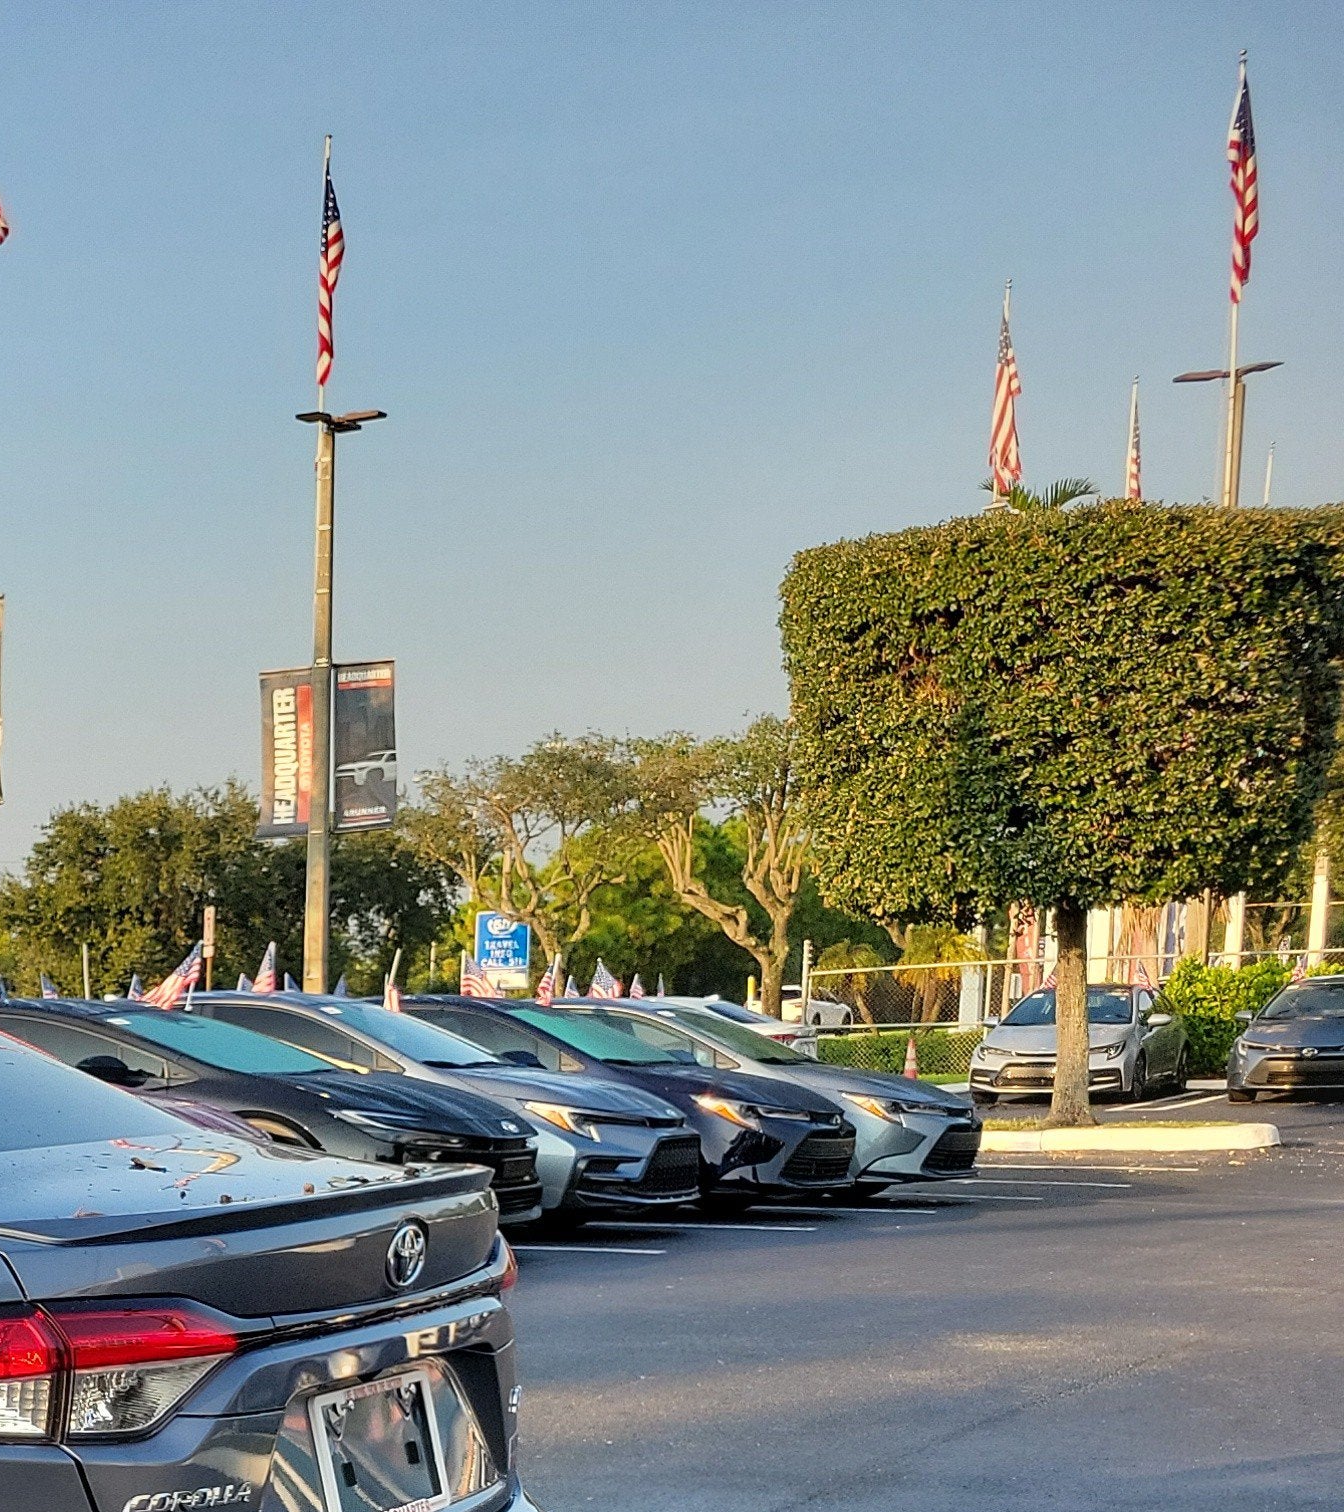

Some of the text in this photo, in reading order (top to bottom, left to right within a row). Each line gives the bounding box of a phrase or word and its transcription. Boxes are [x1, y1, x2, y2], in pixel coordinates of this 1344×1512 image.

[272, 687, 299, 826] HEADQUARTER
[484, 940, 520, 951] TRAVEL
[490, 949, 514, 959] INFO
[481, 957, 503, 967] CALL
